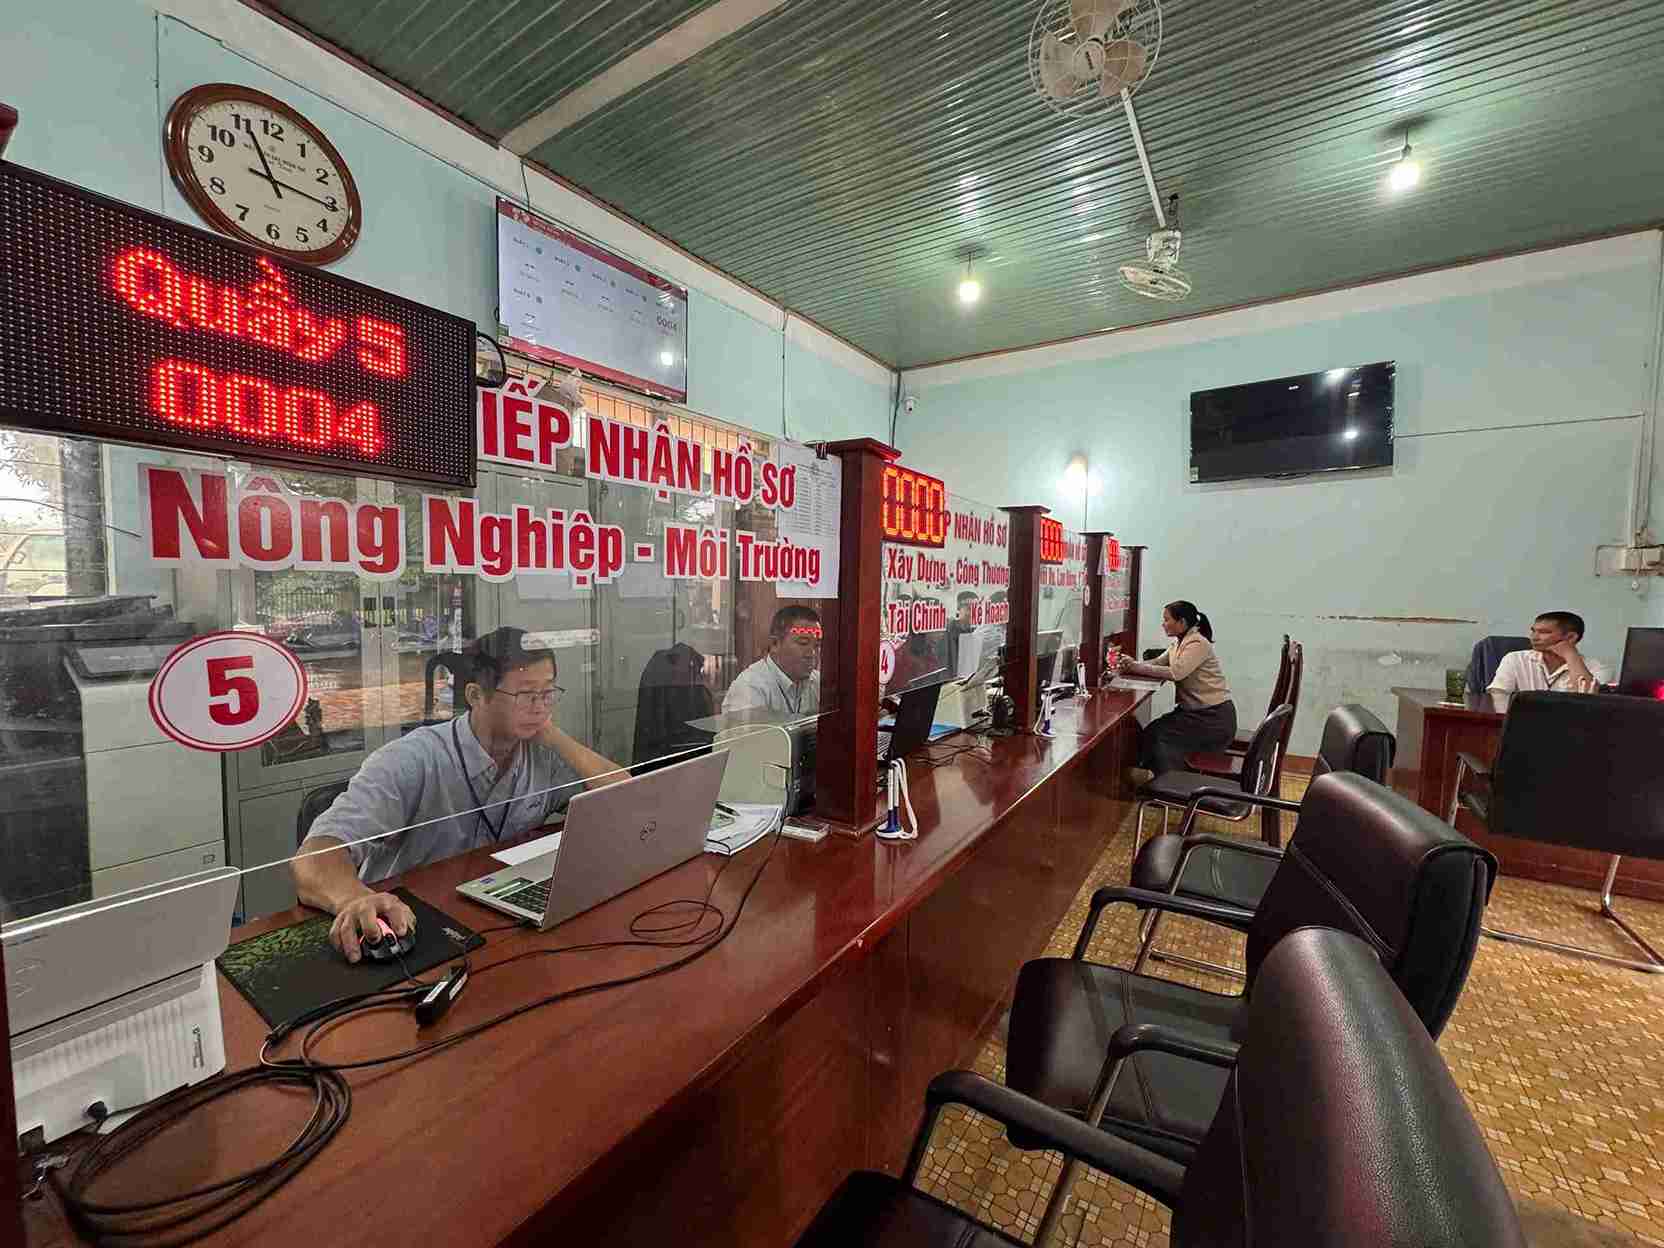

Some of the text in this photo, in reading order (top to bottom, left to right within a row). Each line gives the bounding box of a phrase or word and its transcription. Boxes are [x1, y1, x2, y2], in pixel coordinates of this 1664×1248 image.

[232, 113, 252, 132] 11
[260, 119, 284, 142] 12
[207, 124, 235, 147] 10
[198, 145, 214, 163] 9
[297, 143, 306, 158] 1
[209, 176, 226, 195] 8
[315, 168, 329, 185] 2
[235, 203, 250, 221] 7
[324, 196, 339, 212] 3
[265, 223, 280, 240] 6
[296, 227, 309, 243] 5
[316, 218, 328, 232] 4
[113, 248, 406, 378] Quầy 5
[152, 358, 384, 458] 0004
[479, 378, 572, 466] IẾP
[588, 417, 701, 499] NHẬN
[713, 442, 752, 500] HỒ
[761, 462, 797, 508] SƠ
[147, 468, 821, 585] Nông Nghiệp - Môi Trường
[954, 510, 981, 548] NHẬN
[996, 521, 1008, 548] SƠ
[888, 548, 913, 583] Xây
[918, 552, 947, 589] Dựng
[956, 557, 979, 587] Công
[888, 601, 908, 634] Tài
[912, 600, 946, 631] Chính
[881, 650, 888, 673] 4
[206, 655, 260, 726] 5
